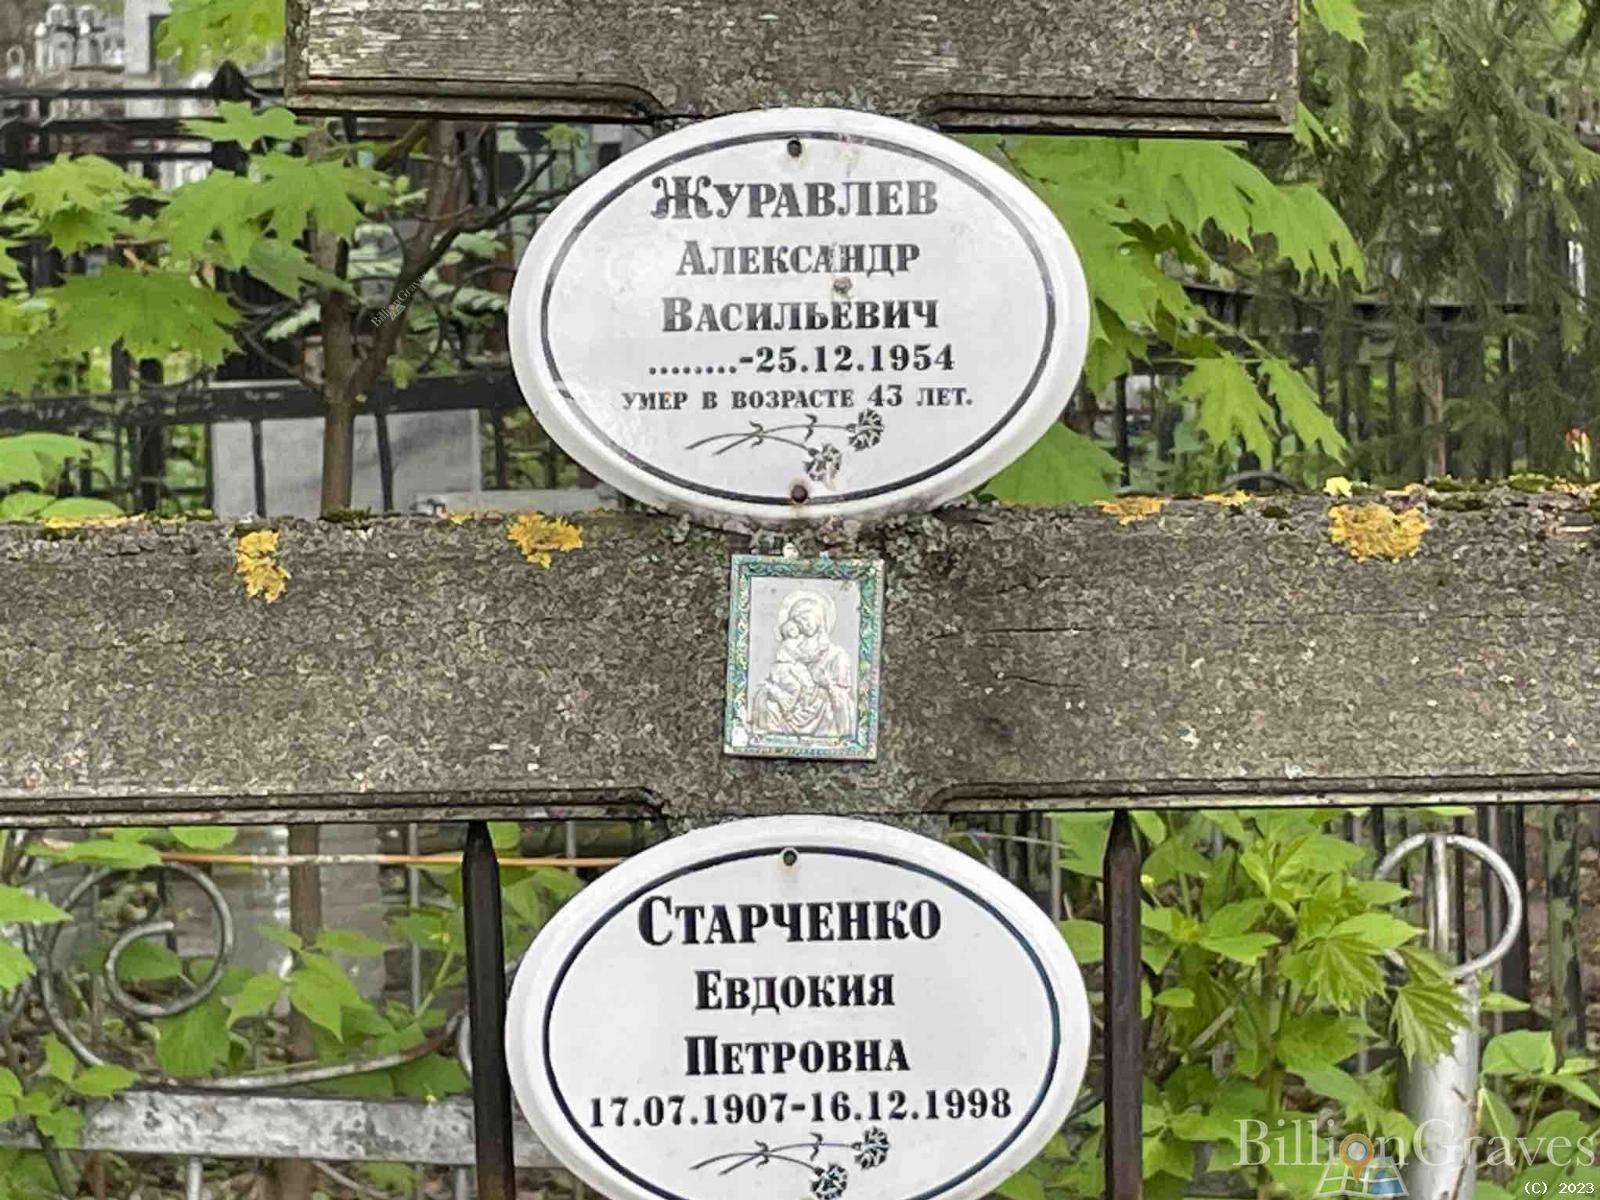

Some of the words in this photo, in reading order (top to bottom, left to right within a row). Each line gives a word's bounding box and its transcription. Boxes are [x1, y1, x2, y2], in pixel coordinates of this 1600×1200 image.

[650, 175, 939, 220] ЖУРАВЛЕВ
[676, 239, 921, 279] АЛЕКСАНДР
[662, 296, 939, 333] ВАСИЛЬЕВИЧ
[622, 390, 688, 412] УМЕР
[702, 390, 719, 411] В
[732, 388, 854, 410] ВОЗРАСТЕ
[867, 383, 904, 408] 43
[917, 385, 973, 408] ЛЕТ.
[637, 895, 942, 947] СТАРЧЕНКО
[694, 969, 895, 1016] ЕВДОКИЯ
[684, 1035, 911, 1077] ПЕТРОВНА
[589, 1087, 1013, 1128] 17.07.1907-16.12.1998
